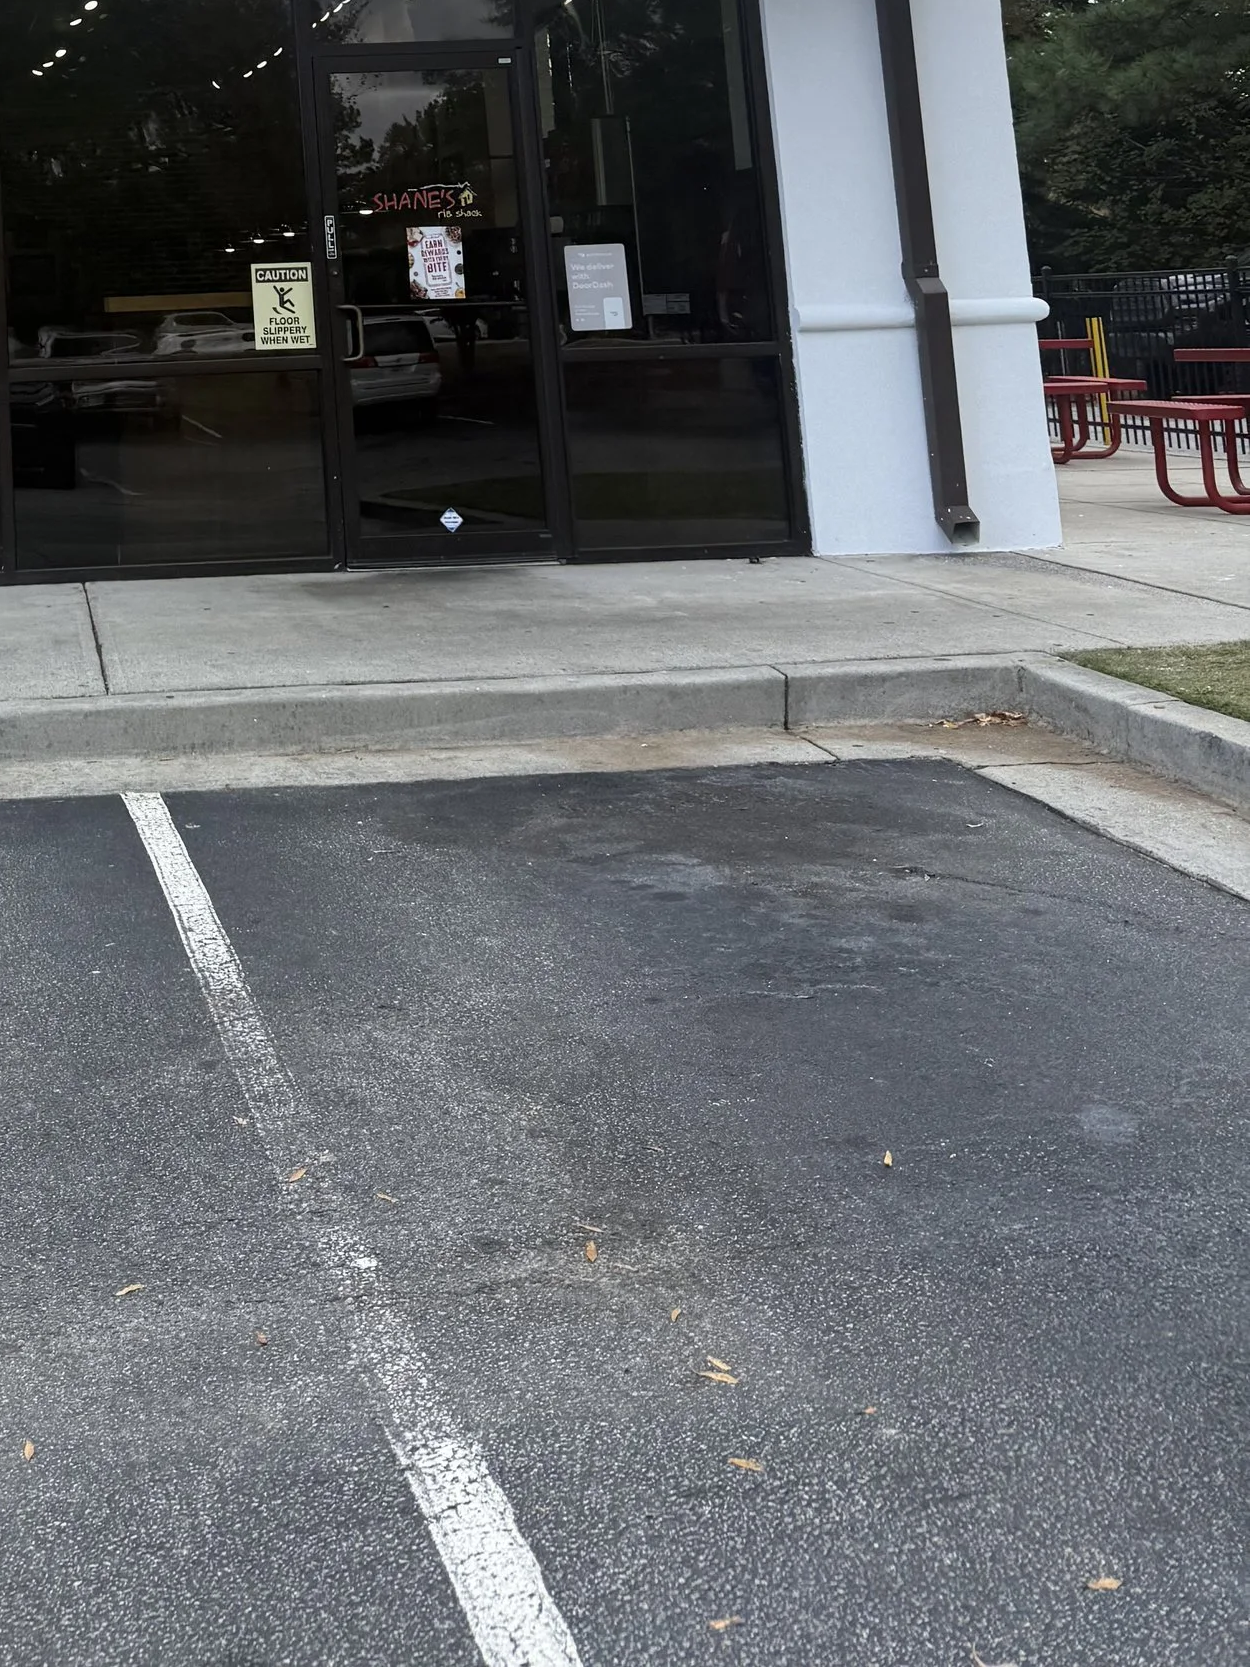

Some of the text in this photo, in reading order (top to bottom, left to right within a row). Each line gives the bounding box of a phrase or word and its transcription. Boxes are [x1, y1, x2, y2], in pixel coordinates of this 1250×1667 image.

[372, 189, 455, 212] SHANE'S
[326, 219, 334, 248] PULL
[425, 239, 443, 249] EARN
[427, 262, 447, 273] BITE
[256, 269, 307, 281] CAUTION
[572, 281, 614, 289] DoorDash
[269, 317, 300, 325] FLOOR
[263, 326, 307, 335] SLIPPERY
[260, 335, 310, 345] WHEN WET
